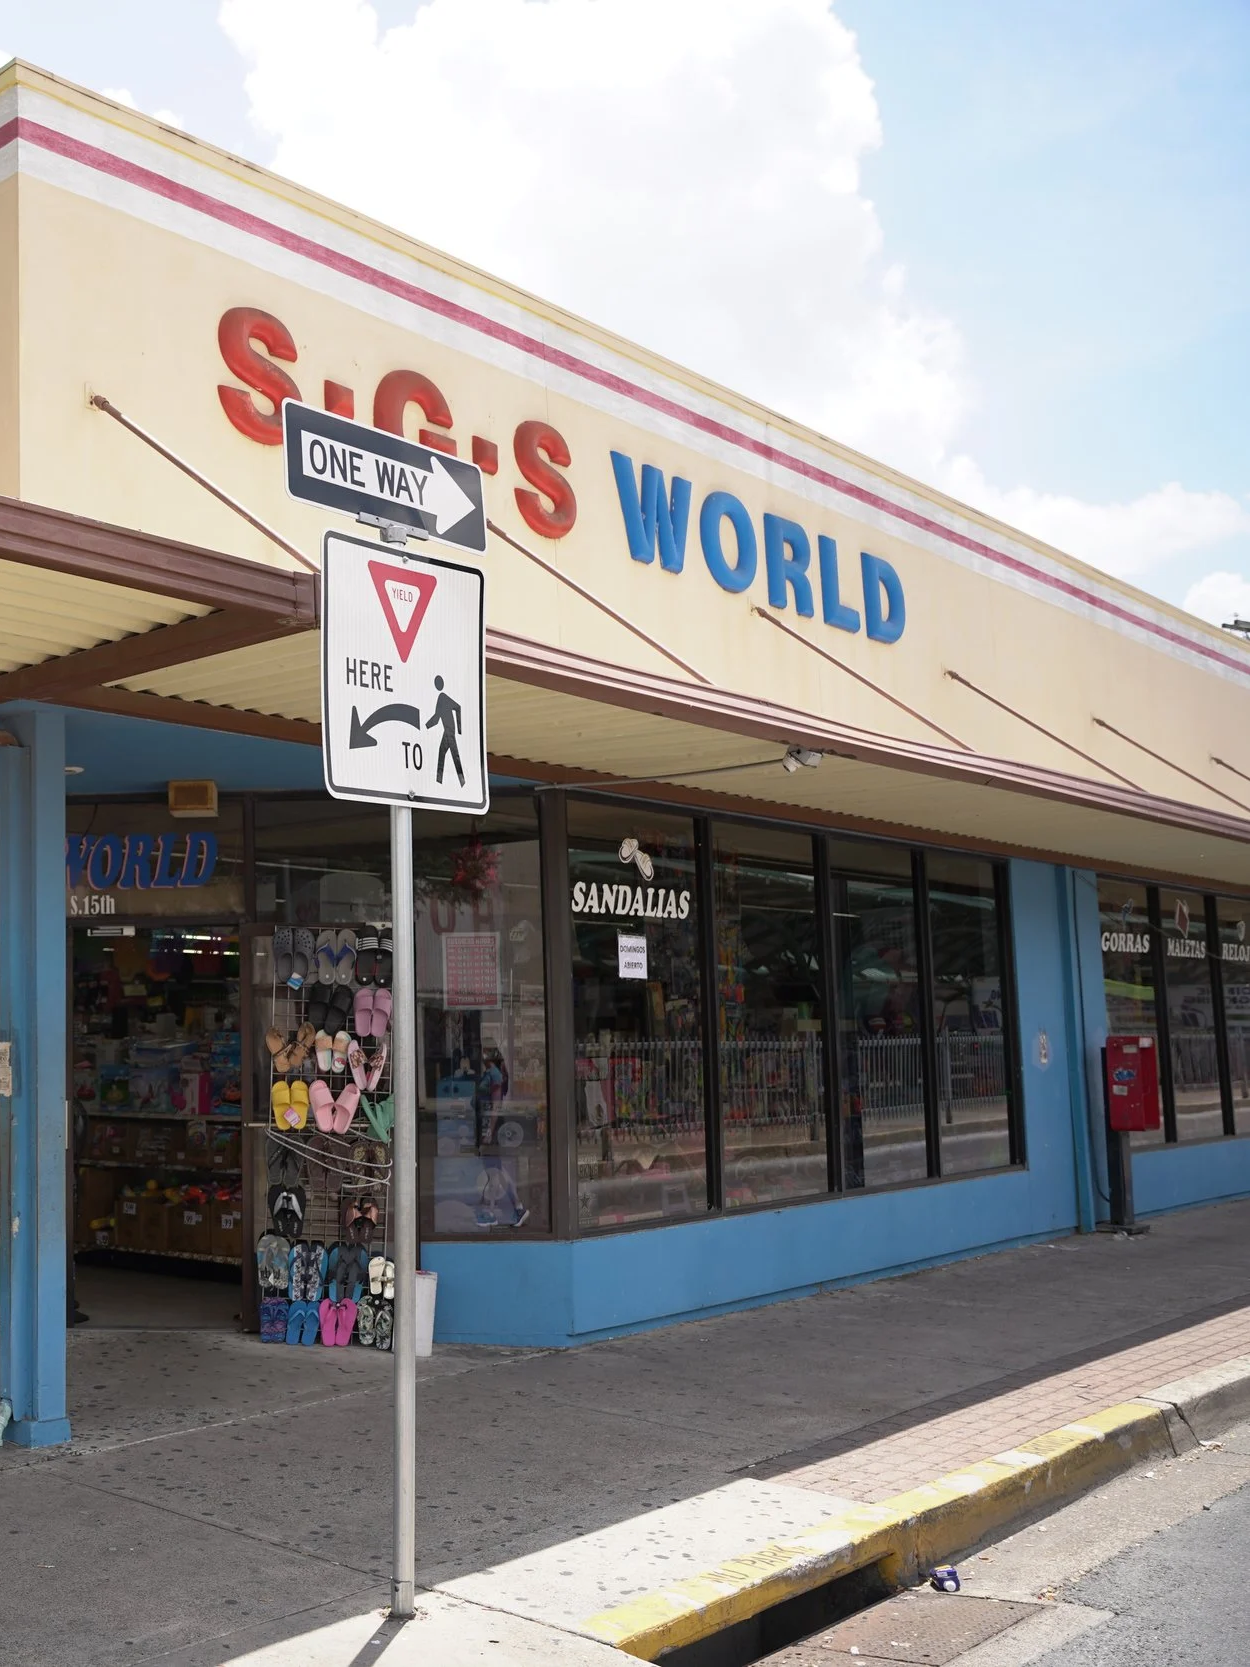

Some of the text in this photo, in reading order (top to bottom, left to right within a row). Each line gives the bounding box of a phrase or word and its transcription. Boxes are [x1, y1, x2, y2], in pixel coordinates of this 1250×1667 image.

[309, 439, 428, 506] ONE WAY
[609, 449, 907, 645] WORLD
[391, 587, 414, 603] YIELD
[346, 656, 394, 693] HERE
[401, 741, 423, 771] TO
[571, 881, 691, 920] SANDALIAS
[619, 945, 646, 954] DOMINGOS
[1101, 931, 1150, 953] GORRAS
[1167, 938, 1207, 960] MALETAS
[623, 961, 644, 970] ABIERTO
